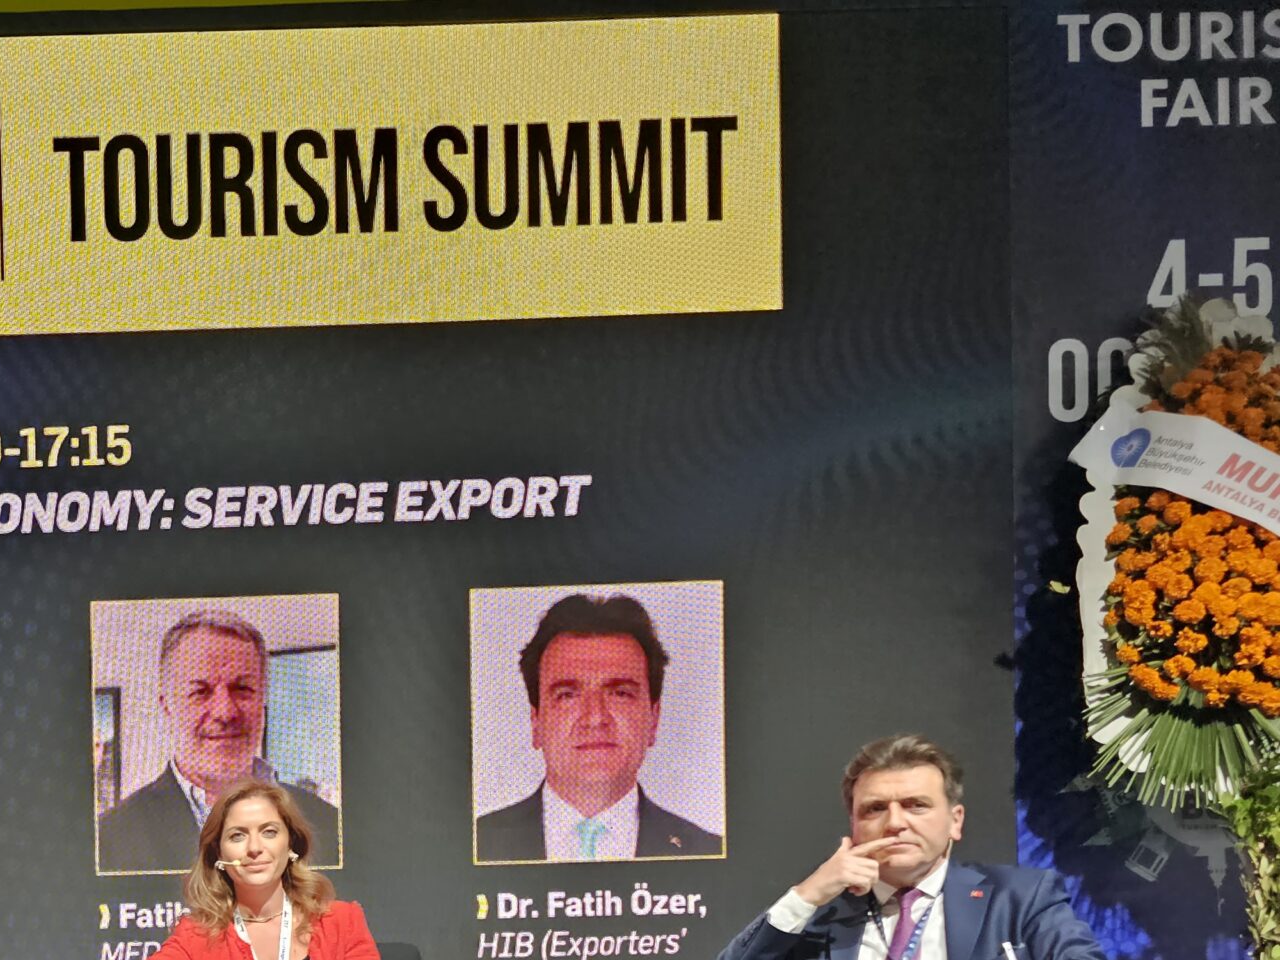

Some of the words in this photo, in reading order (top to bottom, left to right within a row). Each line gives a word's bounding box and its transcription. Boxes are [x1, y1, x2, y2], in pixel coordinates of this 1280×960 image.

[1140, 77, 1276, 128] FAIR
[52, 128, 399, 243] TOURISM
[422, 115, 738, 232] SUMMIT
[1147, 237, 1272, 319] 4-5
[181, 480, 388, 529] SERVICE
[393, 474, 593, 523] EXPORT
[1201, 480, 1266, 512] ANTALYA
[497, 893, 538, 920] Dr.
[547, 889, 622, 917] Fatih
[631, 882, 707, 919] Özer,
[477, 931, 534, 959] HIB
